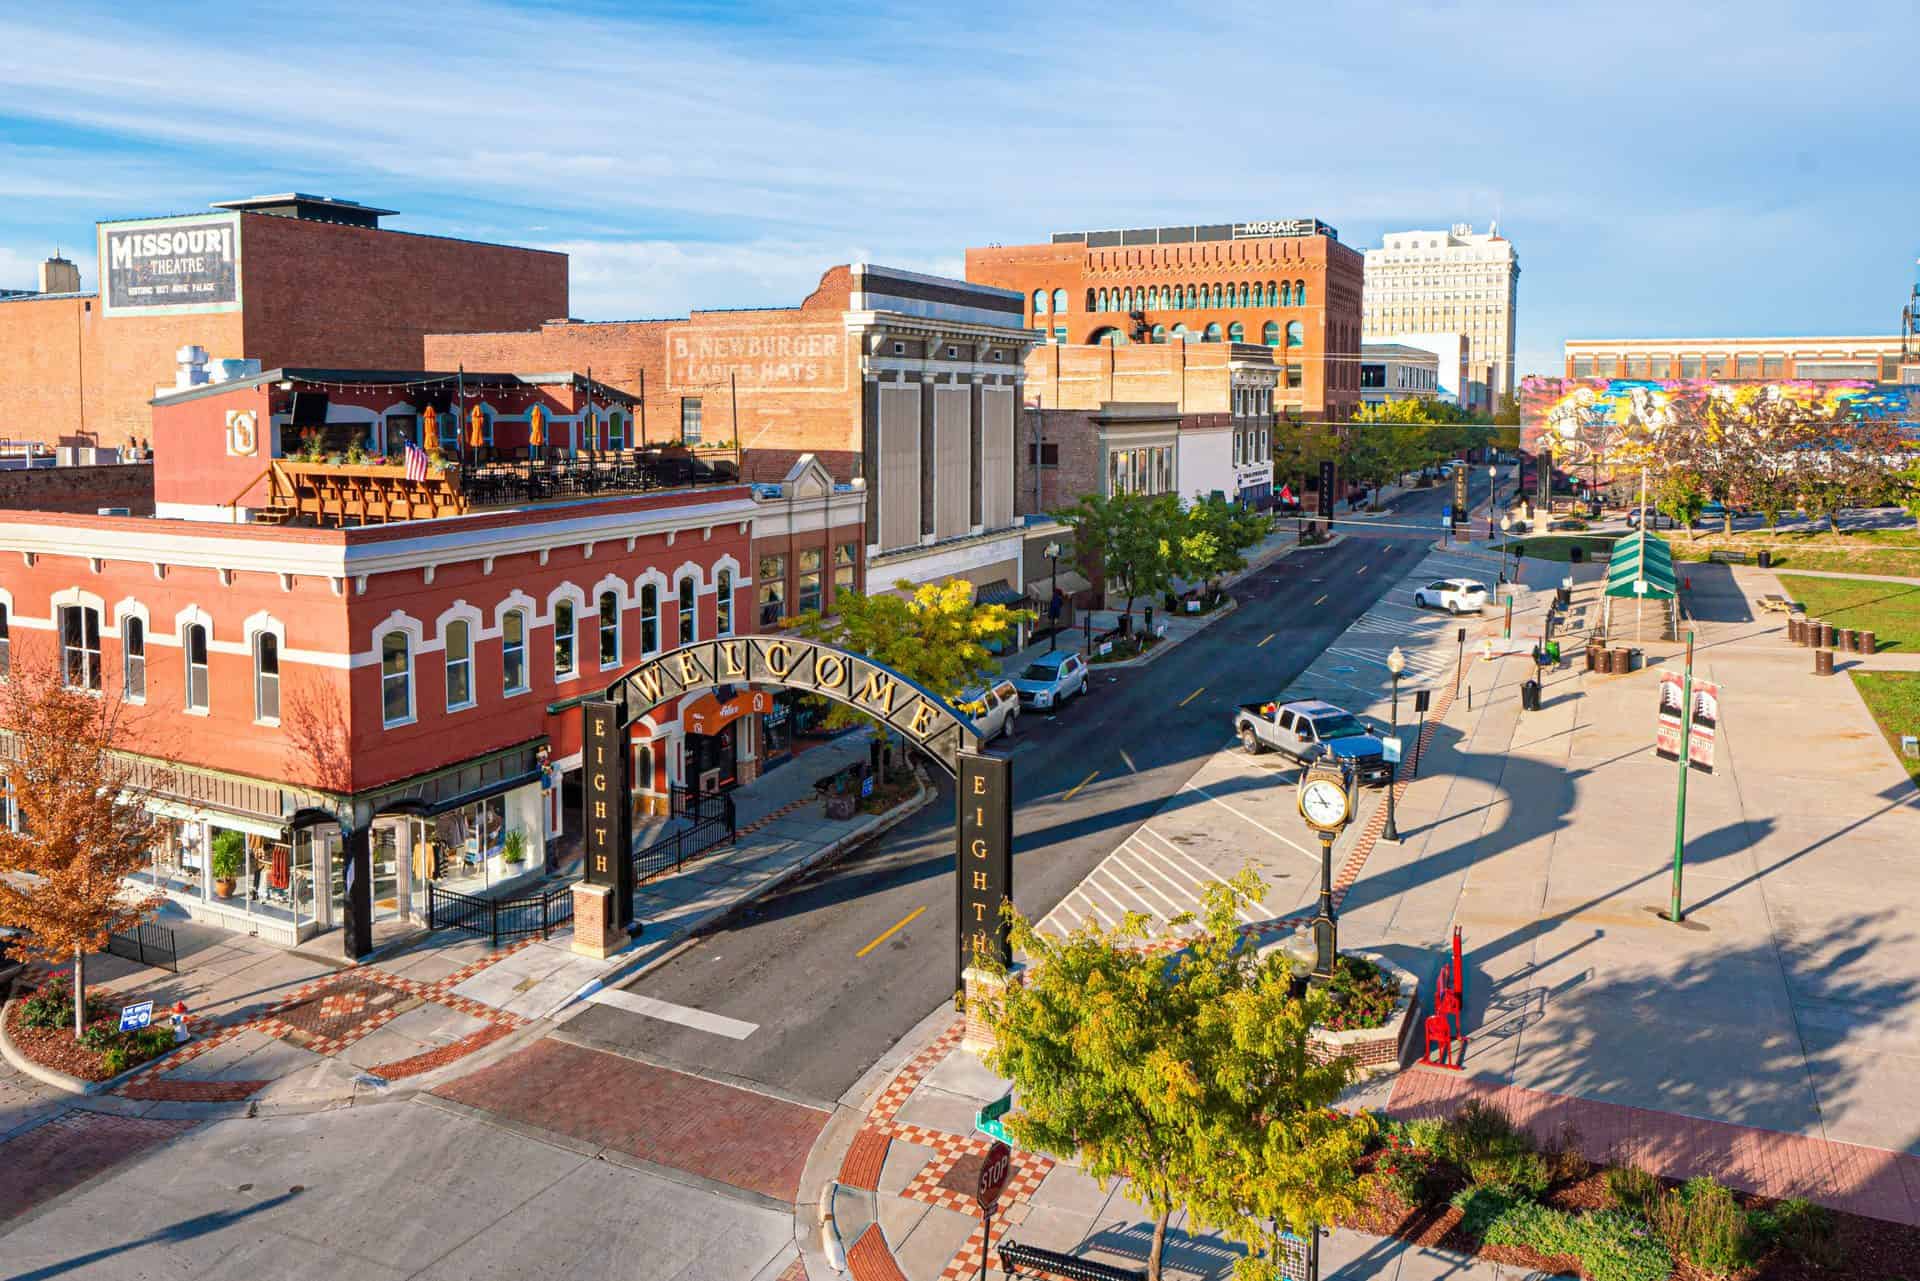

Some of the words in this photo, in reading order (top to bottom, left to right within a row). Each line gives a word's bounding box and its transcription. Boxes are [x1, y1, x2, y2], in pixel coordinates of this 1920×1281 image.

[1245, 220, 1300, 234] MOSAIC
[111, 228, 232, 270] MISSOURI
[150, 257, 205, 274] THEATRE
[701, 334, 838, 358] NEWBURGER
[759, 362, 818, 382] HATS
[635, 642, 940, 738] WELCOME
[593, 719, 608, 873] EIGHTH
[971, 775, 988, 954] EIGHTH
[981, 1155, 1009, 1194] STOP
